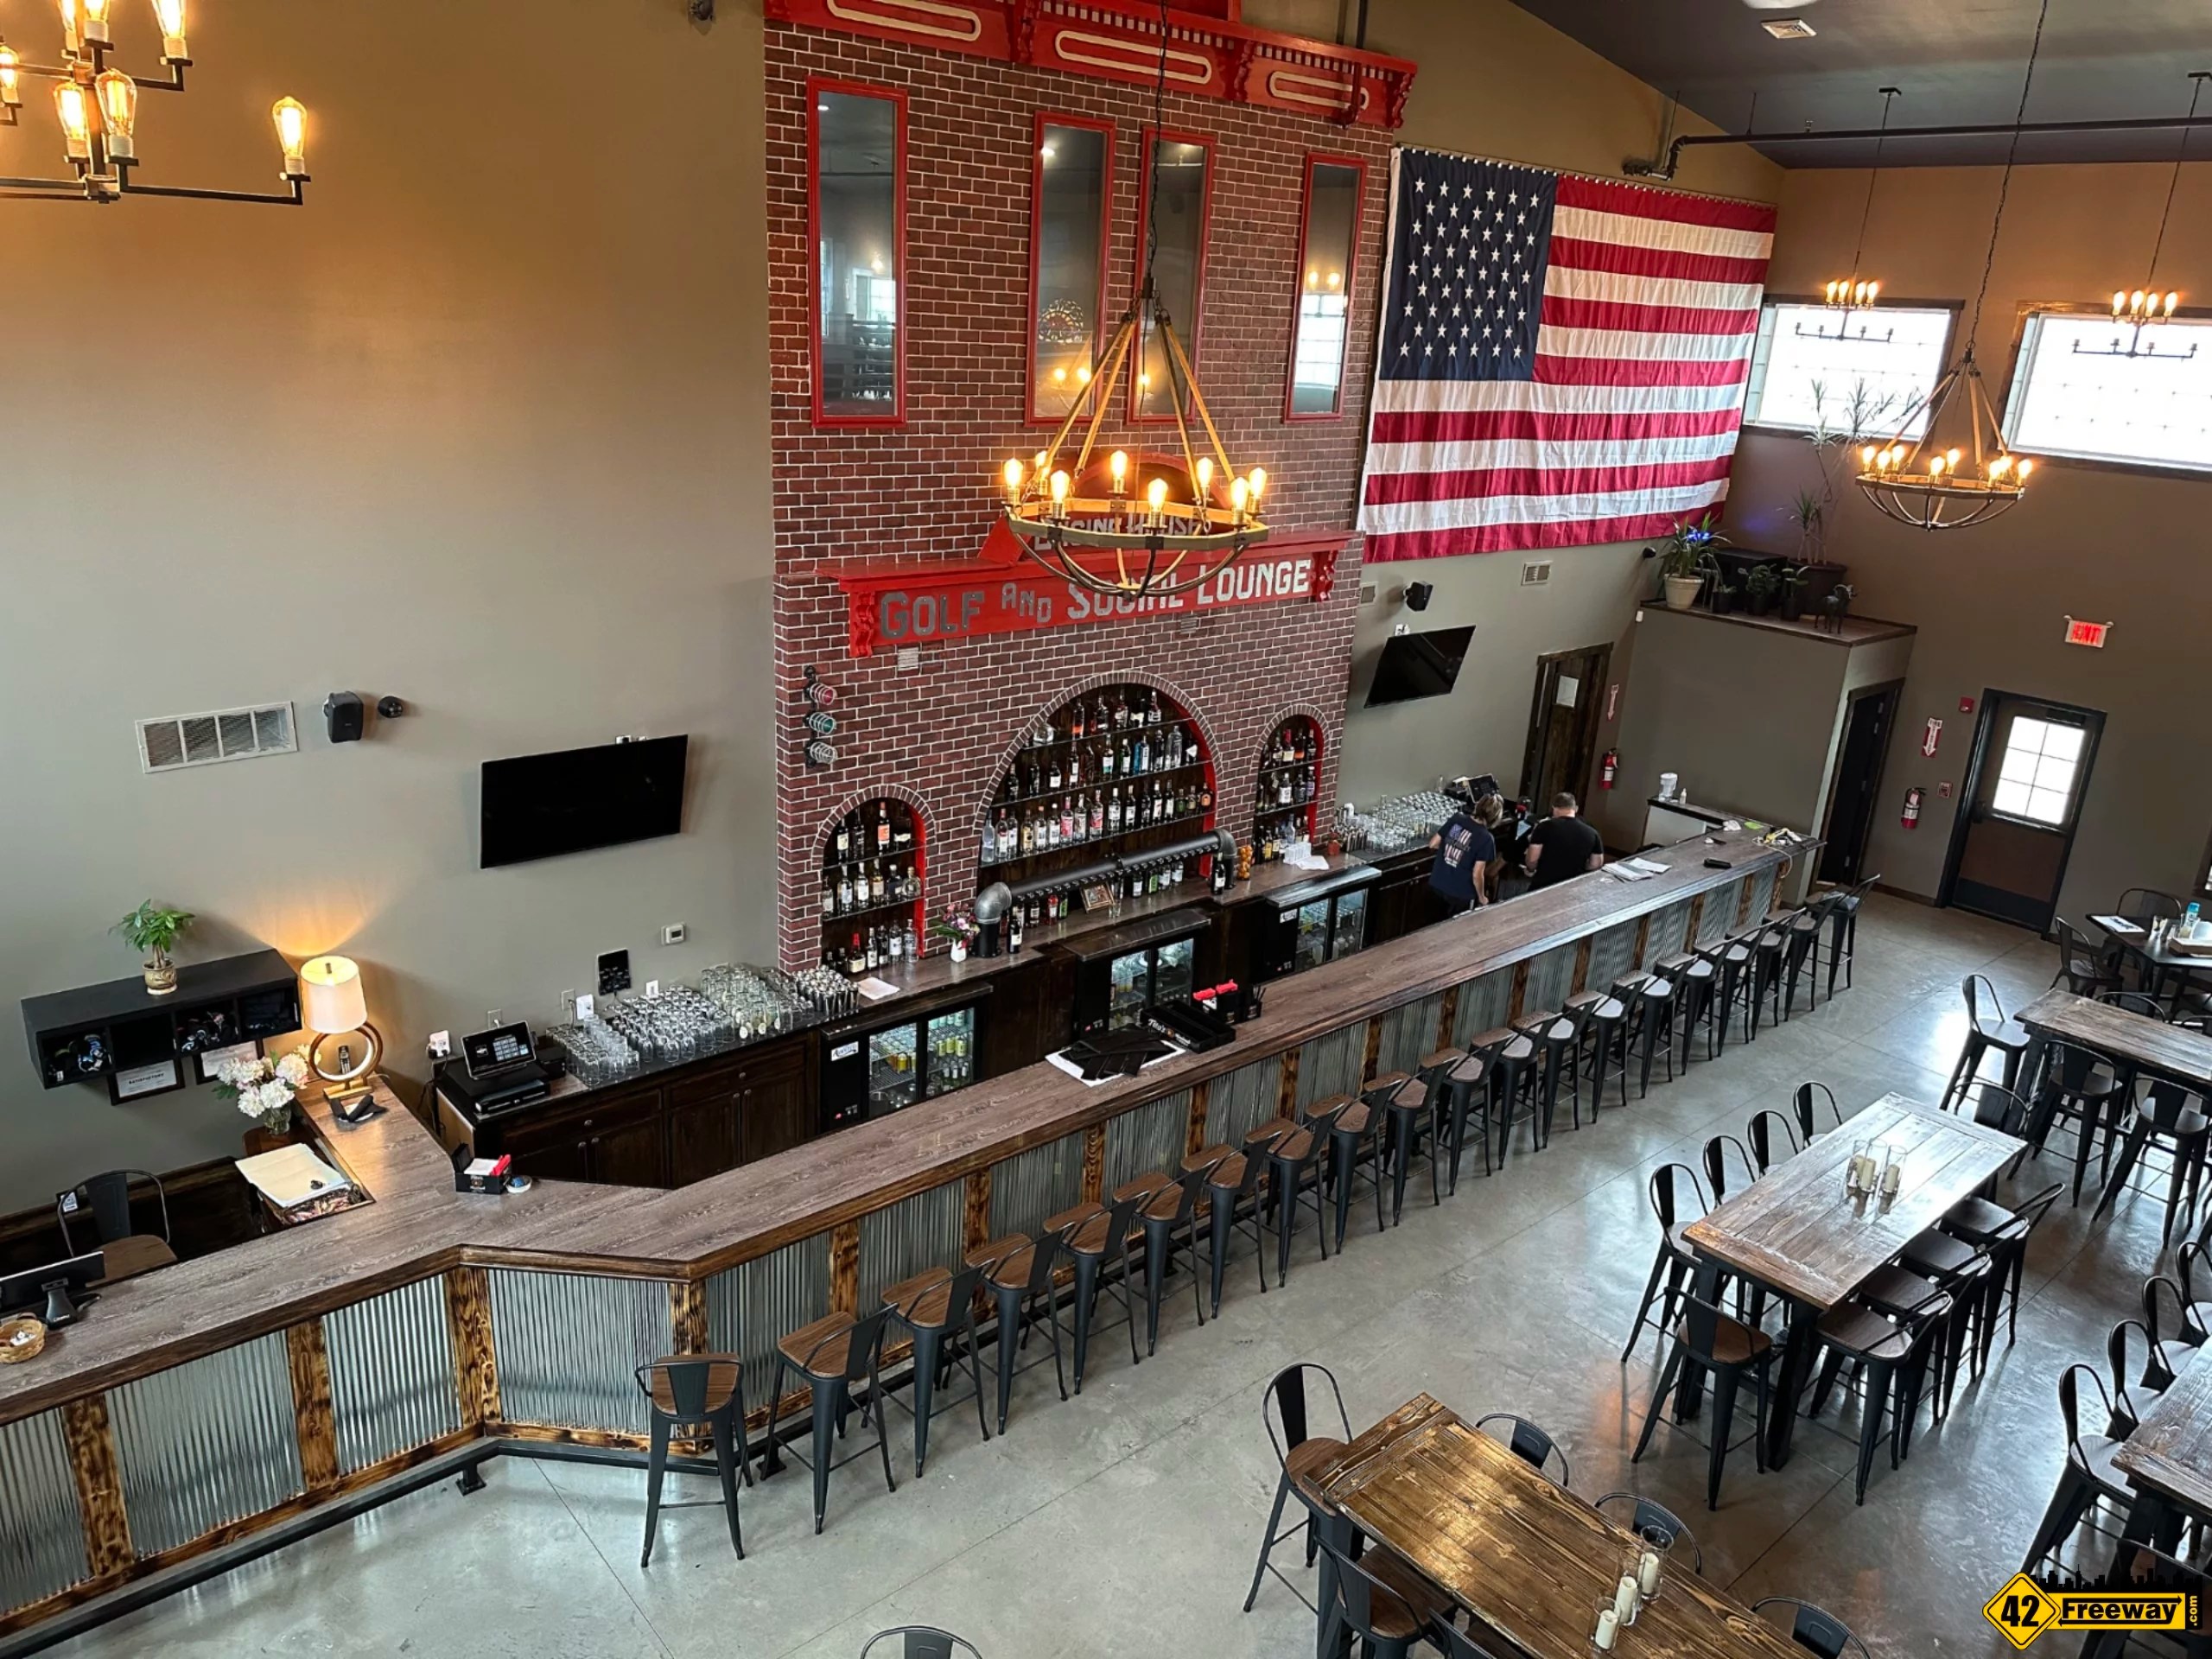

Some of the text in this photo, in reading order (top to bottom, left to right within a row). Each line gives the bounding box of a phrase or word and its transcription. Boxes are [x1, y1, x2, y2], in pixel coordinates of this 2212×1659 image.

[880, 591, 985, 639] GOLF
[1001, 582, 1052, 623] AND
[1198, 559, 1312, 605] LOUNGE
[2072, 623, 2102, 645] EXIT
